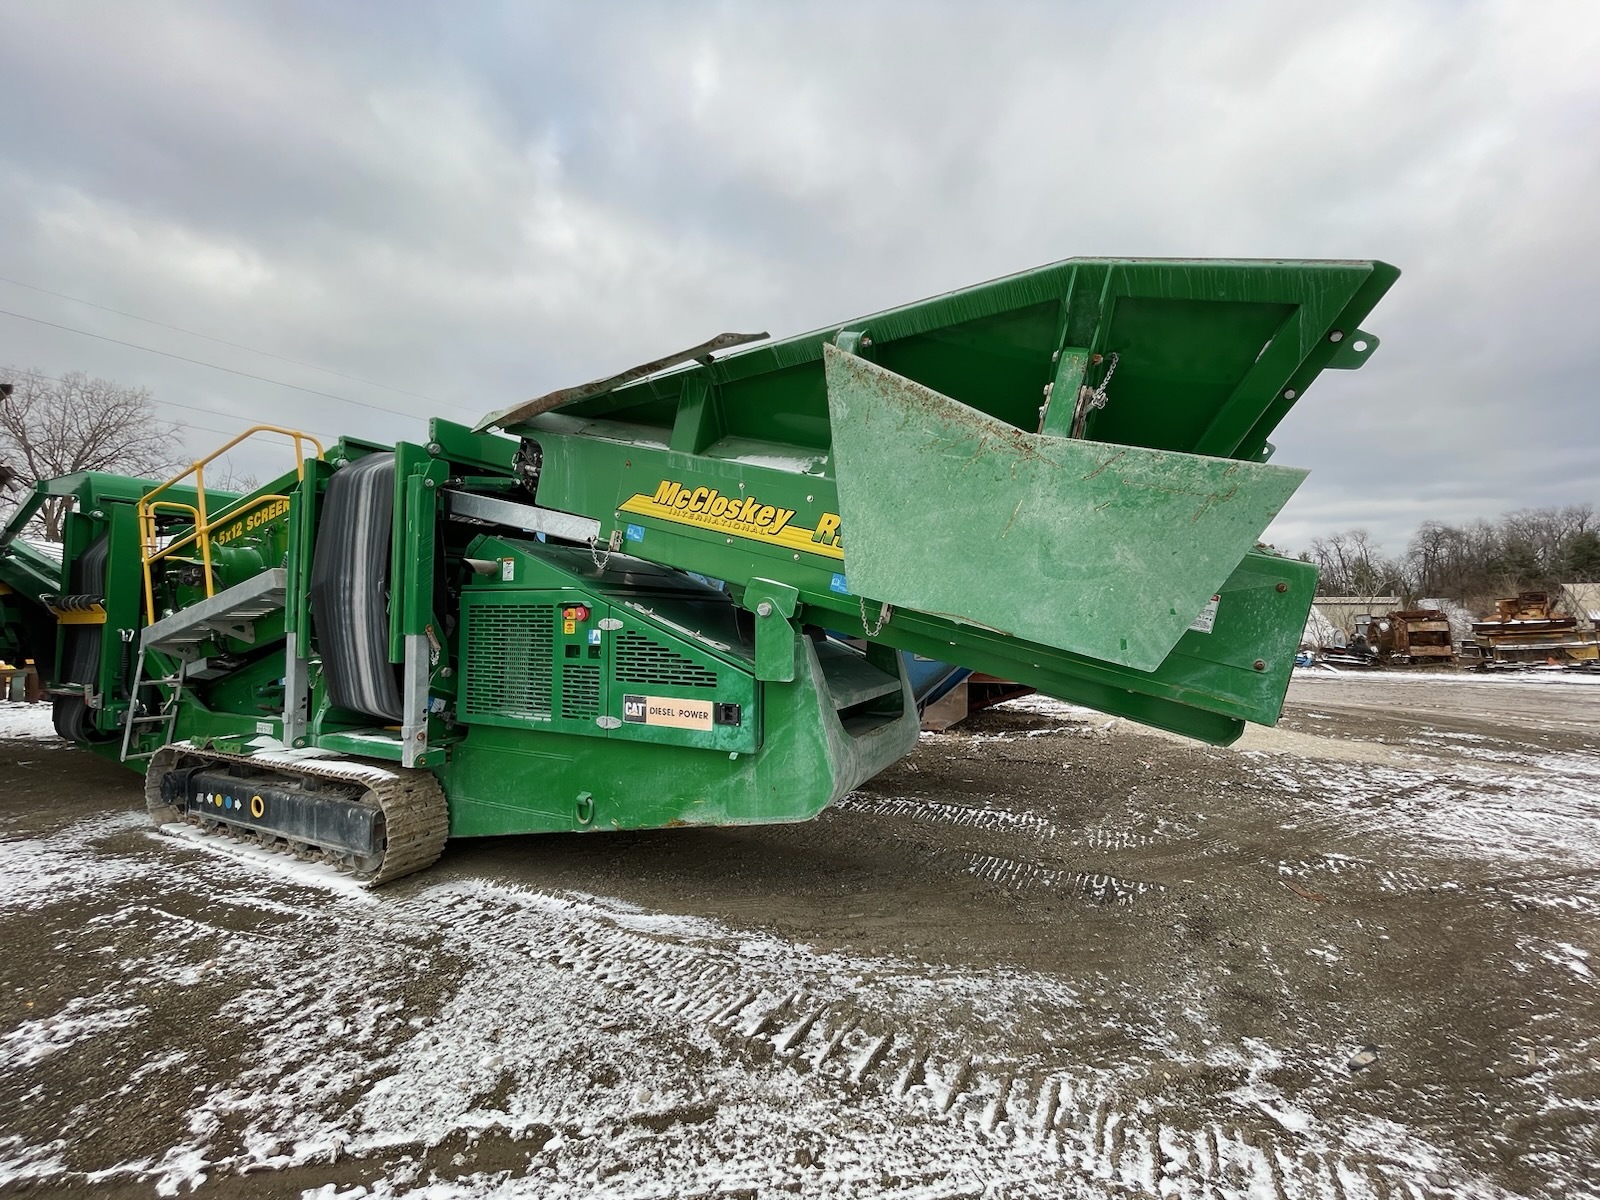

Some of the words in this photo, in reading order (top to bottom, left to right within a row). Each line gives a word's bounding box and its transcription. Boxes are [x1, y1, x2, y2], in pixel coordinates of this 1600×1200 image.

[653, 479, 797, 536] McCloskey
[669, 508, 768, 536] INTERNATIONAL
[625, 702, 647, 717] CAT
[650, 707, 675, 717] DIESEL
[678, 709, 709, 720] POWER
